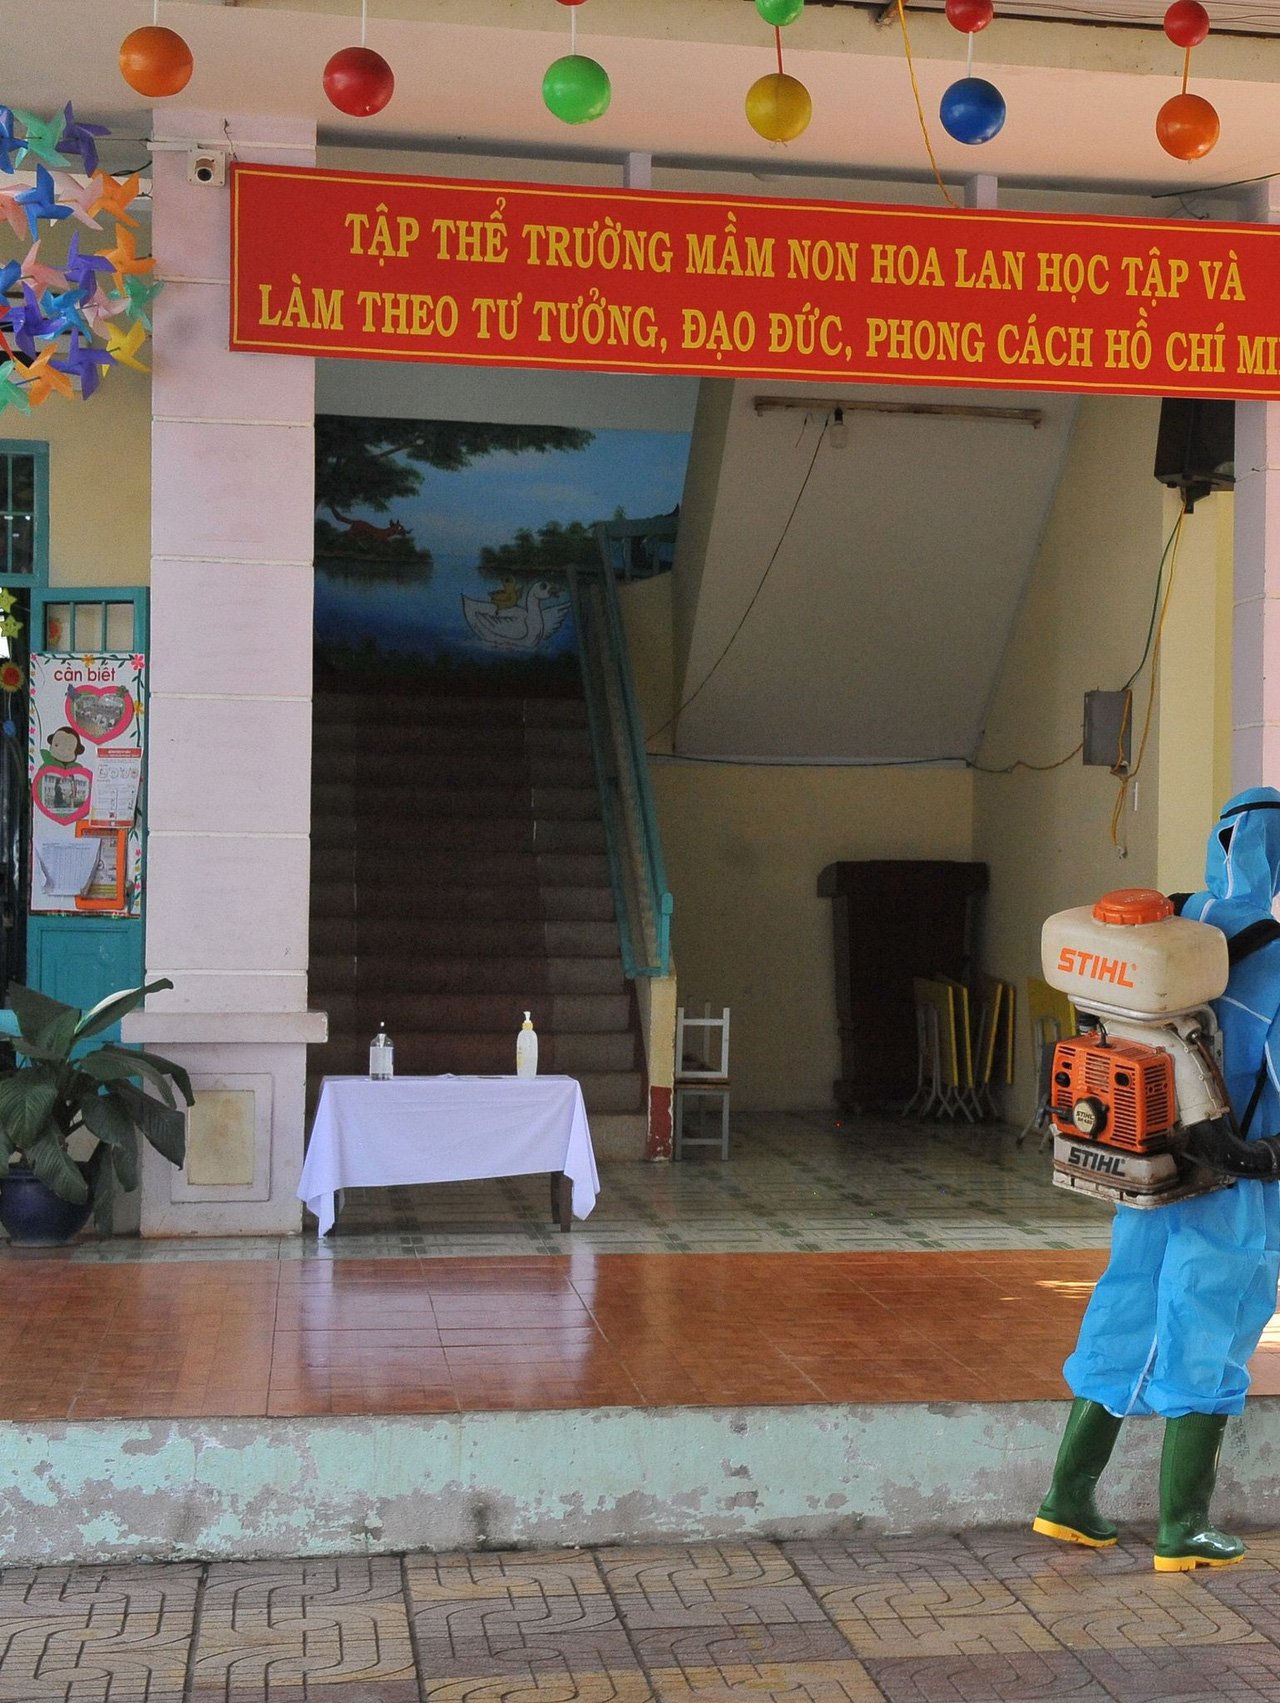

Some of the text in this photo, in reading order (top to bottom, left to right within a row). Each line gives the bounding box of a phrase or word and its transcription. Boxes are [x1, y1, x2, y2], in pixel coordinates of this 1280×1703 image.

[345, 196, 1246, 307] TẬP THỂ TRƯỜNG MẦM NON HOA LAN HỌC TẬP VÀ
[259, 273, 345, 331] LÀM
[357, 291, 459, 338] THEO
[471, 292, 523, 341] TƯ
[533, 287, 667, 353] TƯỞNG,
[681, 308, 756, 361] ĐẠO
[768, 302, 853, 361] ĐỨC,
[865, 317, 986, 363] PHONG
[997, 313, 1094, 368] CÁCH
[1104, 307, 1152, 370] HỒ
[1165, 322, 1226, 373] CHÍ
[53, 661, 116, 683] cần biết
[1057, 947, 1136, 988] STIHL
[1076, 1110, 1095, 1120] STIHL
[1068, 1147, 1126, 1178] STIHL
